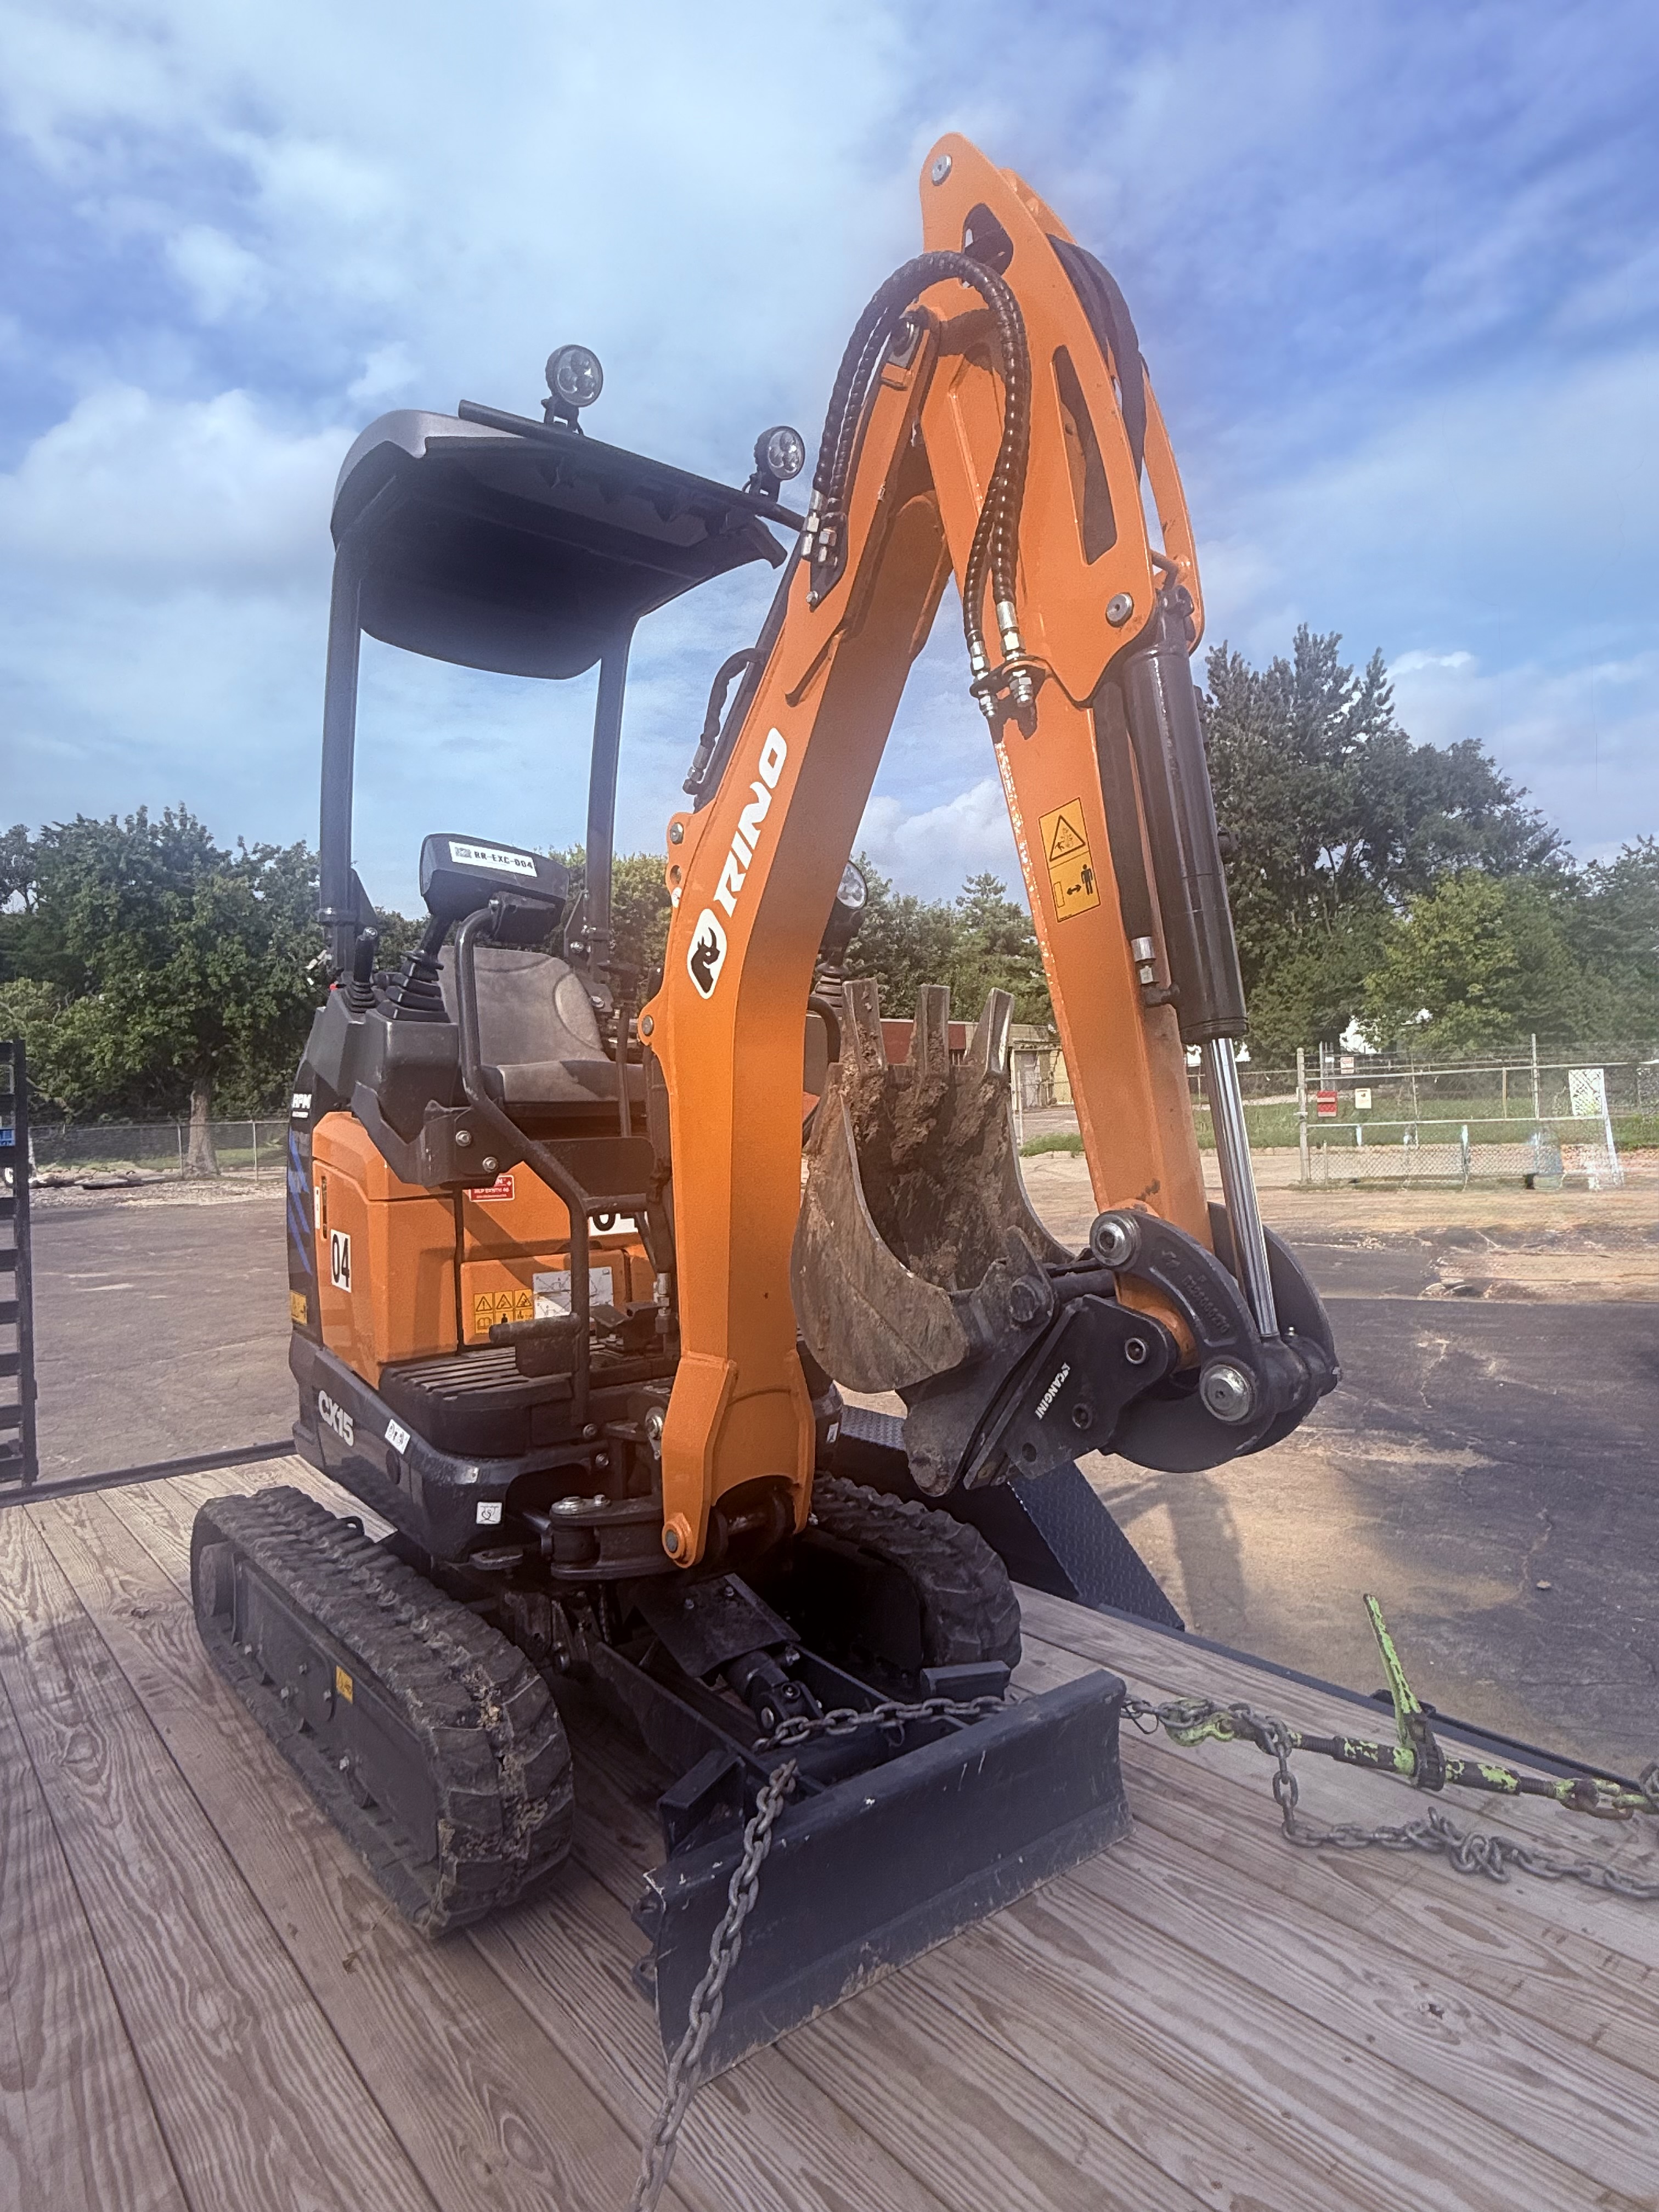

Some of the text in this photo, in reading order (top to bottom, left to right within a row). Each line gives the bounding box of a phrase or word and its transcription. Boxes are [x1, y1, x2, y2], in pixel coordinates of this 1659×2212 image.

[713, 727, 787, 918] RINO
[332, 1233, 350, 1288] 04
[318, 1390, 354, 1447] CX15
